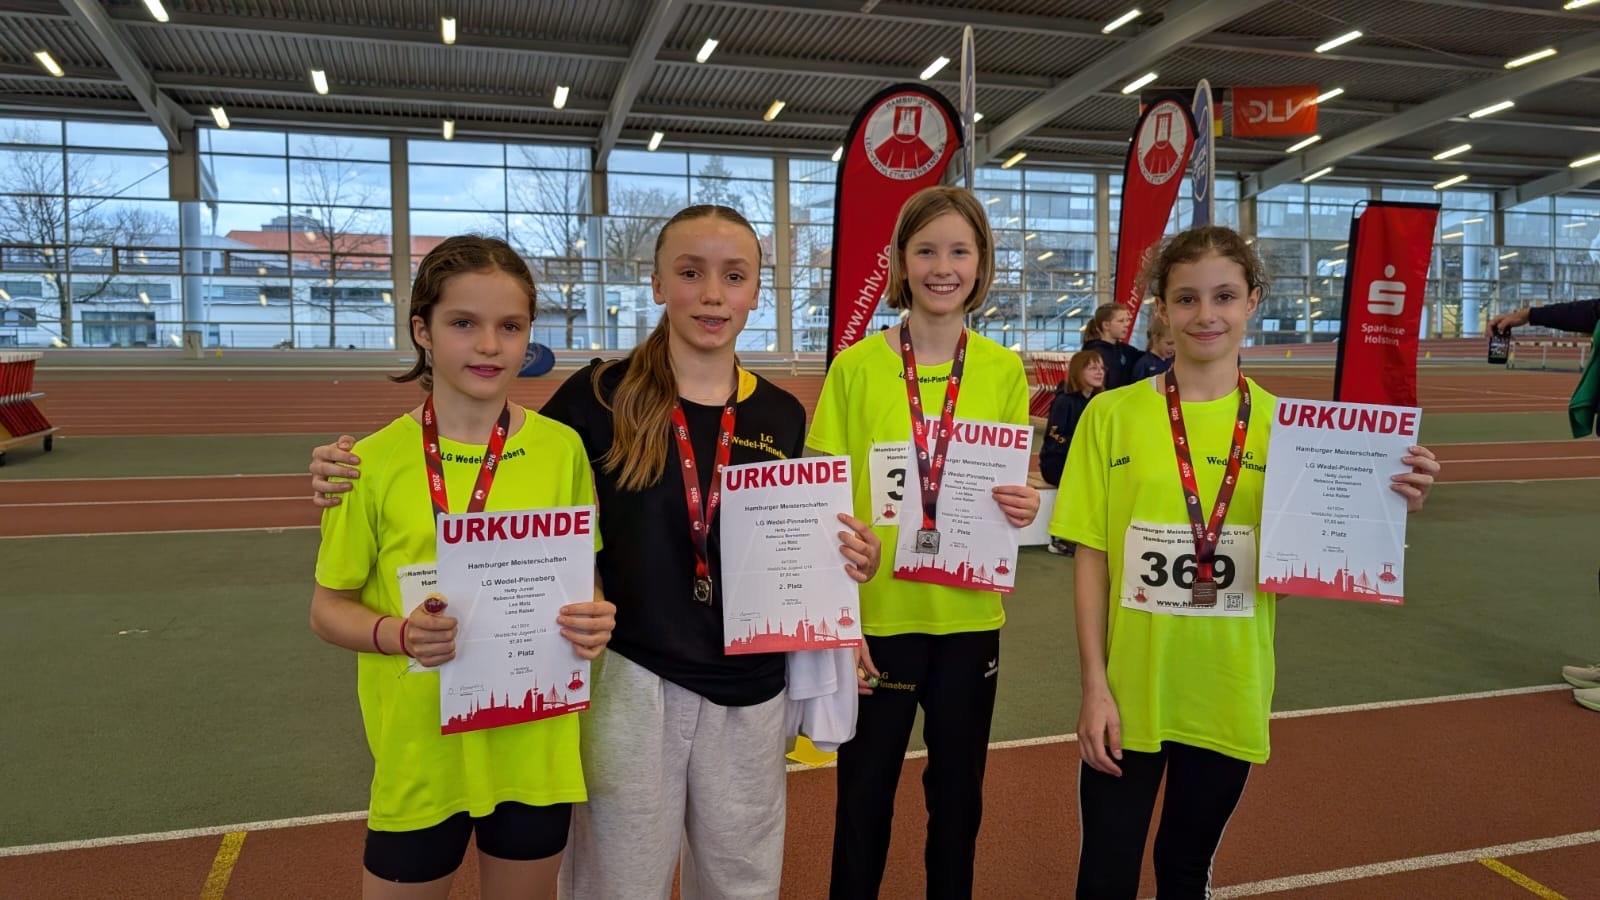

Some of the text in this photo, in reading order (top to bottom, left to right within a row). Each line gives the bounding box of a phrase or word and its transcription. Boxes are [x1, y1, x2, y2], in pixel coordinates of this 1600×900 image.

[1278, 402, 1417, 436] URKUNDE
[760, 432, 774, 443] LG
[441, 452, 453, 462] LG
[1295, 445, 1388, 458] Hamburger Meisterschaften
[726, 460, 848, 491] URKUNDE
[744, 504, 779, 512] Hamburger
[443, 510, 591, 545] URKUNDE
[1330, 530, 1347, 538] Platz
[467, 556, 567, 570] Hamburger Meisterschaften
[1140, 551, 1236, 590] 369
[481, 575, 556, 587] LG Wedel-Pinneberg
[517, 649, 535, 657] Platz
